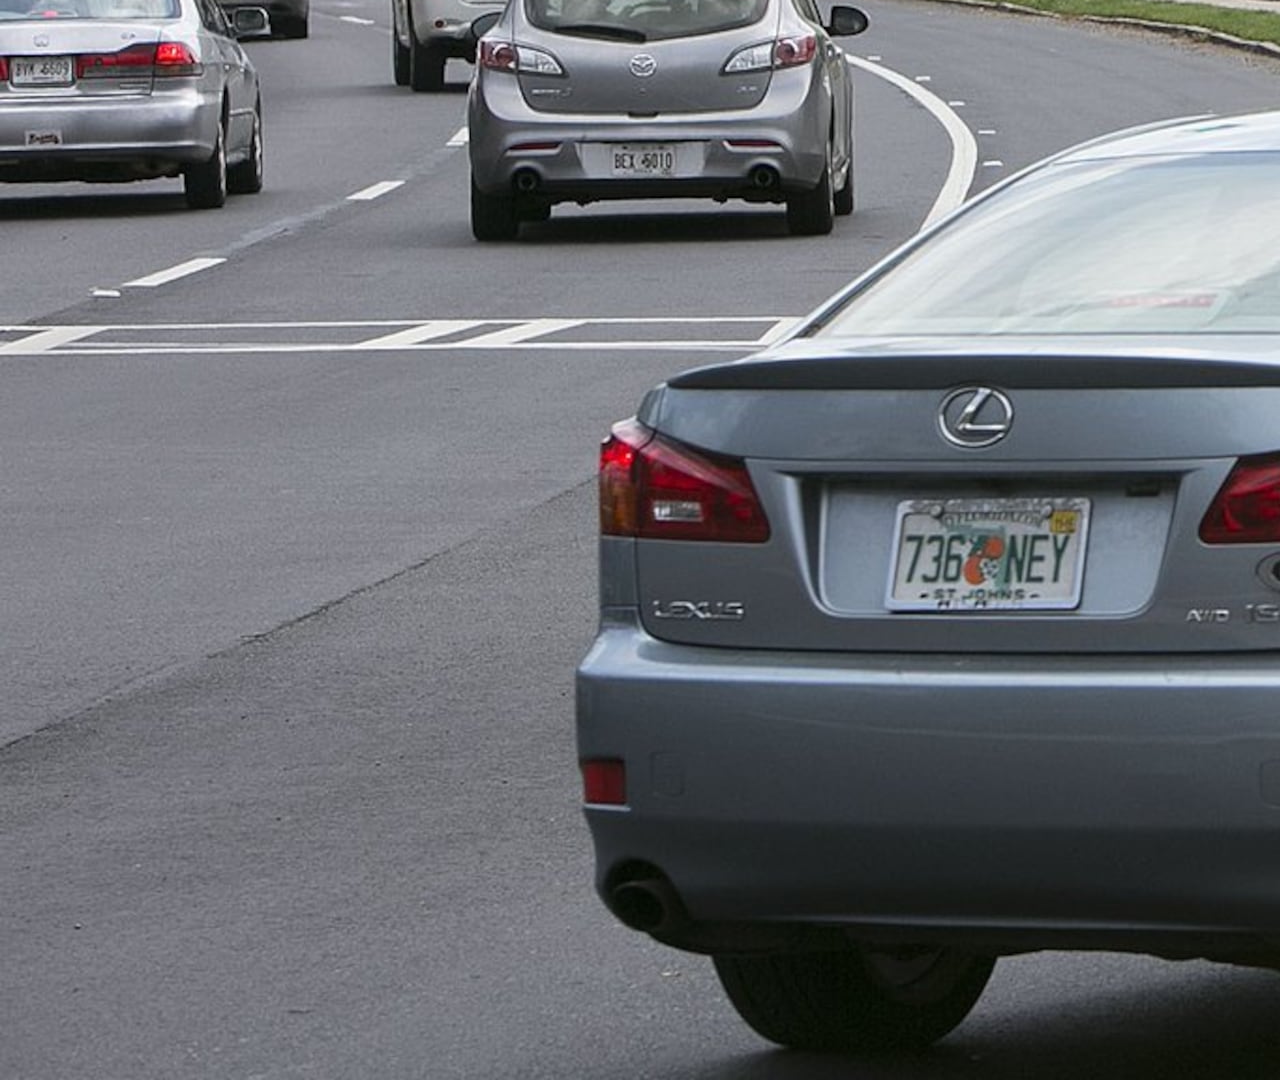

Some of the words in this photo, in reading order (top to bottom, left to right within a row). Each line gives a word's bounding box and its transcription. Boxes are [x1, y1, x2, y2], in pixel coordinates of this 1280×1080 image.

[614, 153, 635, 169] BEX
[905, 534, 965, 583] 736
[1003, 534, 1072, 583] NEY
[933, 588, 957, 600] ST
[962, 588, 1026, 600] JOHNS
[652, 600, 744, 619] LEXUS
[1245, 603, 1280, 622] IS
